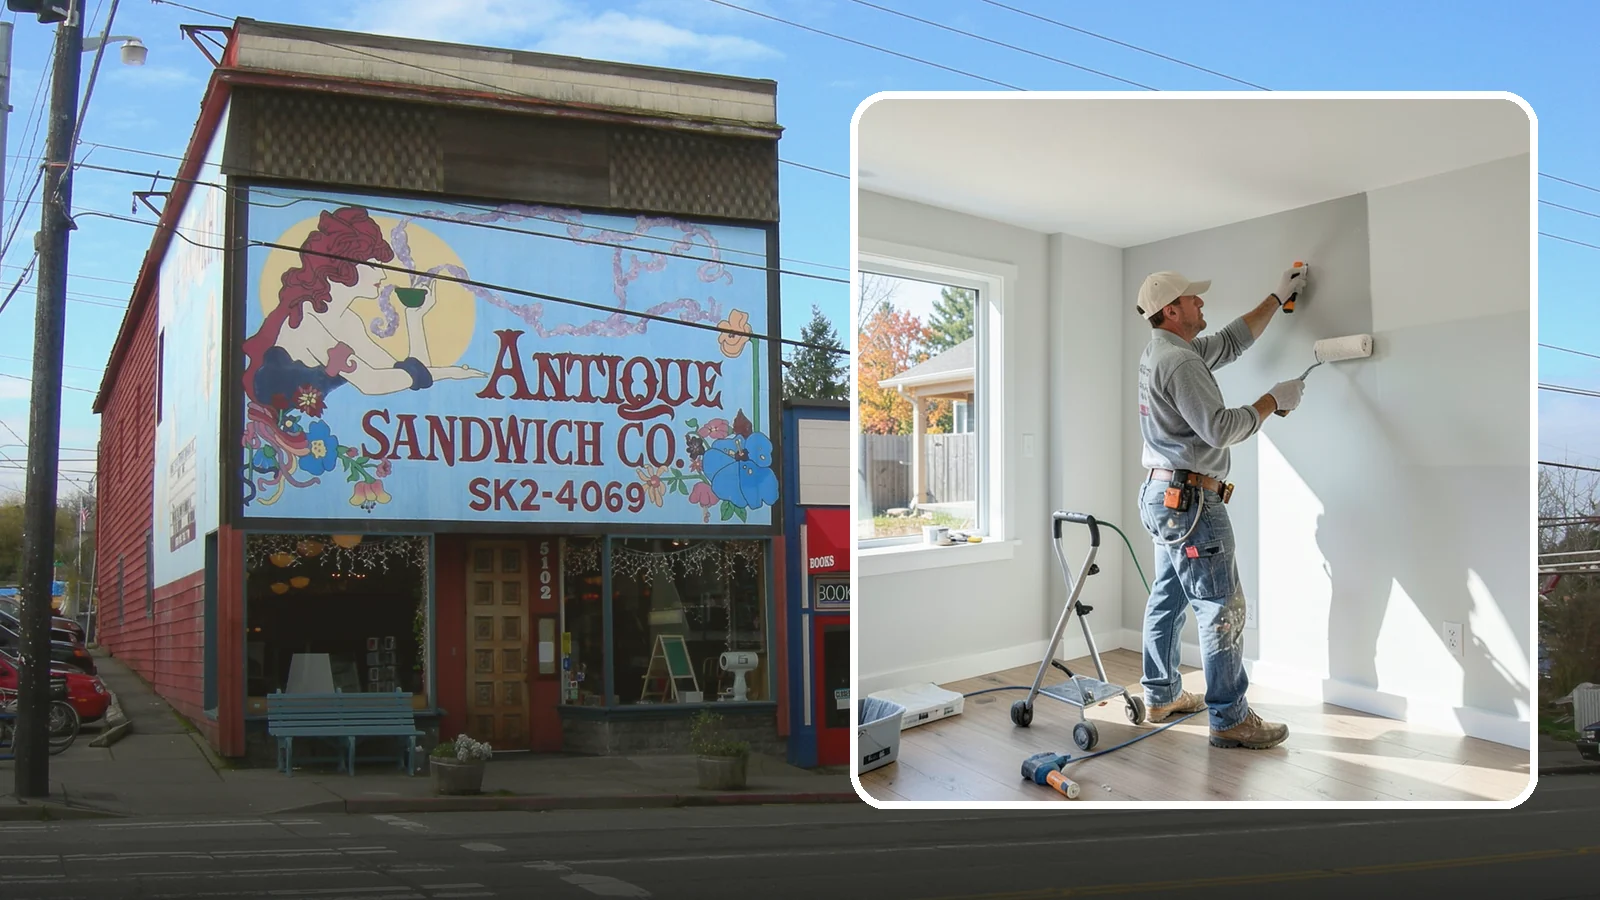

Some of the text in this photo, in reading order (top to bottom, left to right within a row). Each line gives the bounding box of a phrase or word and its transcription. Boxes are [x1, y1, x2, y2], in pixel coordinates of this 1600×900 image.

[475, 329, 724, 421] ANTIQUE
[362, 408, 685, 469] SANDWICH CO.
[468, 477, 646, 513] SK2-4069
[540, 541, 551, 600] 5102
[809, 555, 835, 569] BOOKS
